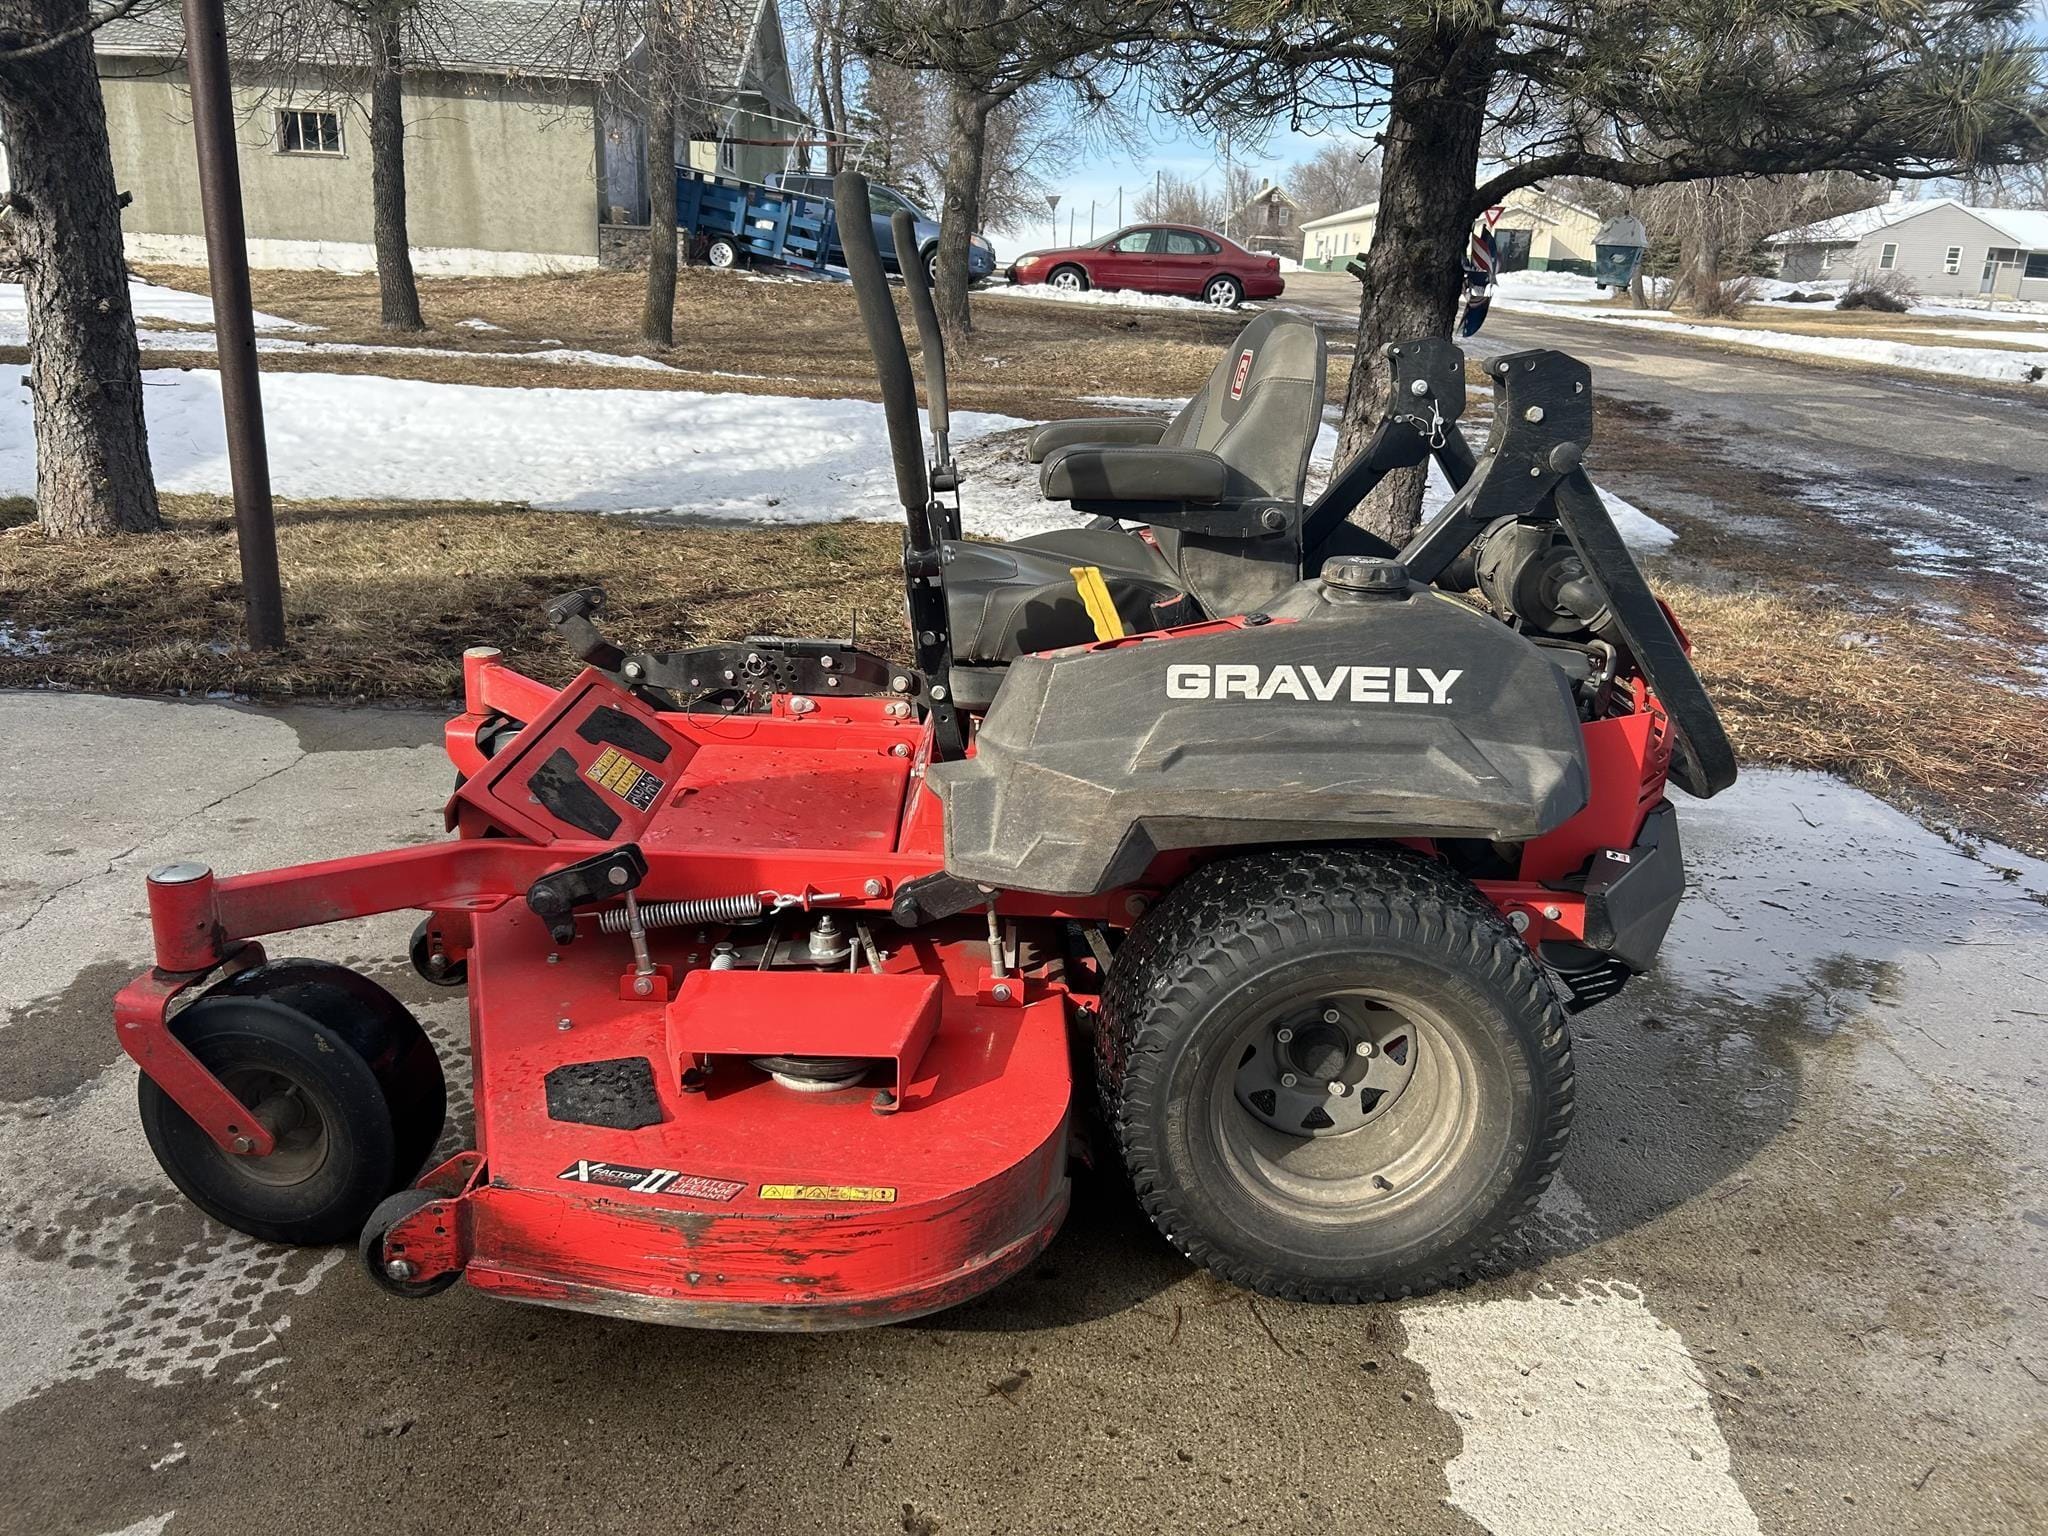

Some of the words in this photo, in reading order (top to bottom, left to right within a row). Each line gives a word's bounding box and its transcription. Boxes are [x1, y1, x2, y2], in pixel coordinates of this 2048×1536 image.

[1234, 358, 1249, 390] G
[671, 1182, 732, 1195] LIFETIME
[678, 1175, 741, 1190] LIMITED
[664, 1187, 731, 1200] WARRANTY
